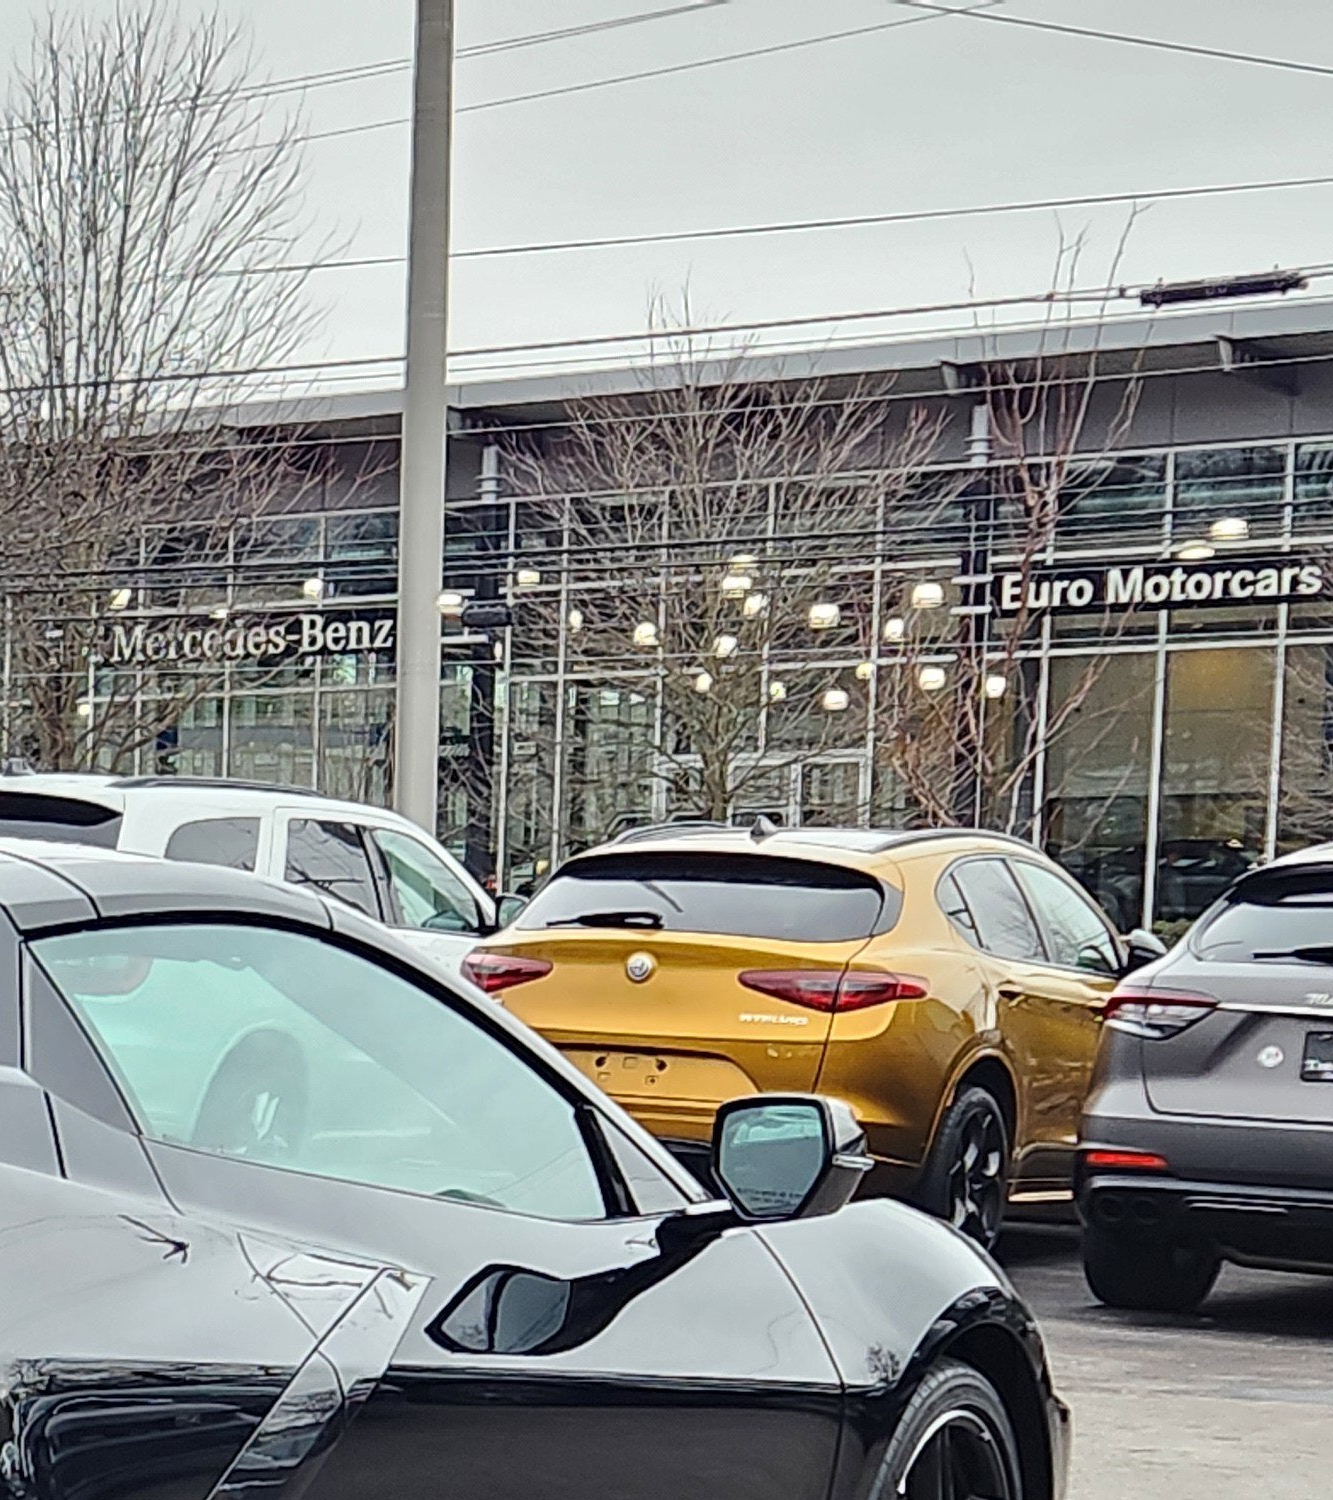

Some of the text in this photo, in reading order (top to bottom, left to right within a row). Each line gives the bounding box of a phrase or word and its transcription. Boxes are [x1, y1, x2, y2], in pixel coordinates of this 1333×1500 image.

[1000, 563, 1324, 611] Euro Motorcars
[111, 613, 395, 664] Mercedes-Benz
